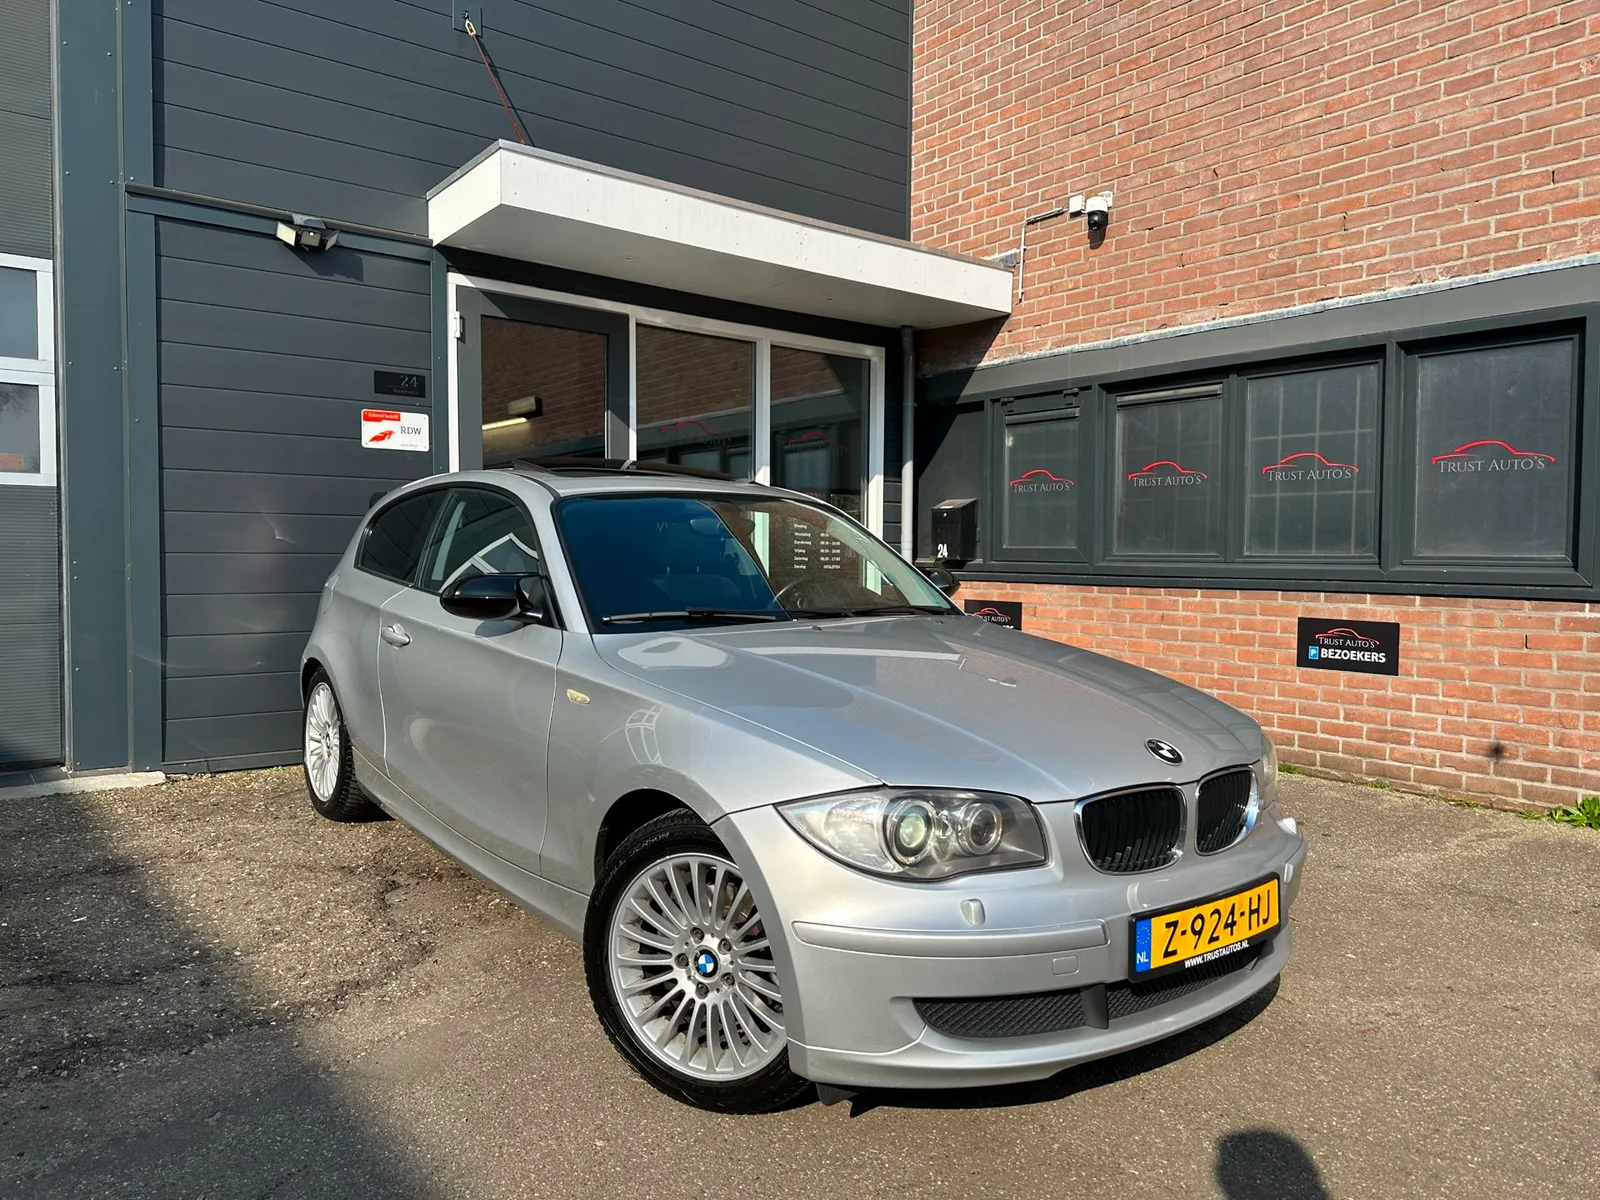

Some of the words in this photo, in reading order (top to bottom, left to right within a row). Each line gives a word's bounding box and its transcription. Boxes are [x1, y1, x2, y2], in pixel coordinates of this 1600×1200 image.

[400, 374, 419, 388] 24
[400, 426, 422, 435] RDW
[1438, 460, 1485, 473] TRUST
[1488, 456, 1546, 471] AUTO'S
[1132, 477, 1163, 487] TRUST
[1164, 474, 1202, 486] AUTO'S
[1267, 470, 1305, 481] TRUST
[1307, 467, 1352, 480] AUTO'S
[1014, 483, 1039, 493] TRUST
[1039, 481, 1070, 492] AUTO'S
[937, 543, 949, 558] 24
[1318, 637, 1344, 646] TRUST
[1345, 639, 1375, 649] AUTO'S
[1321, 648, 1386, 663] BEZOEKERS
[1163, 889, 1271, 959] Z-924-HJ
[1136, 950, 1150, 965] NL
[1184, 939, 1250, 969] WWW.TRUSTAUTOS.NL
